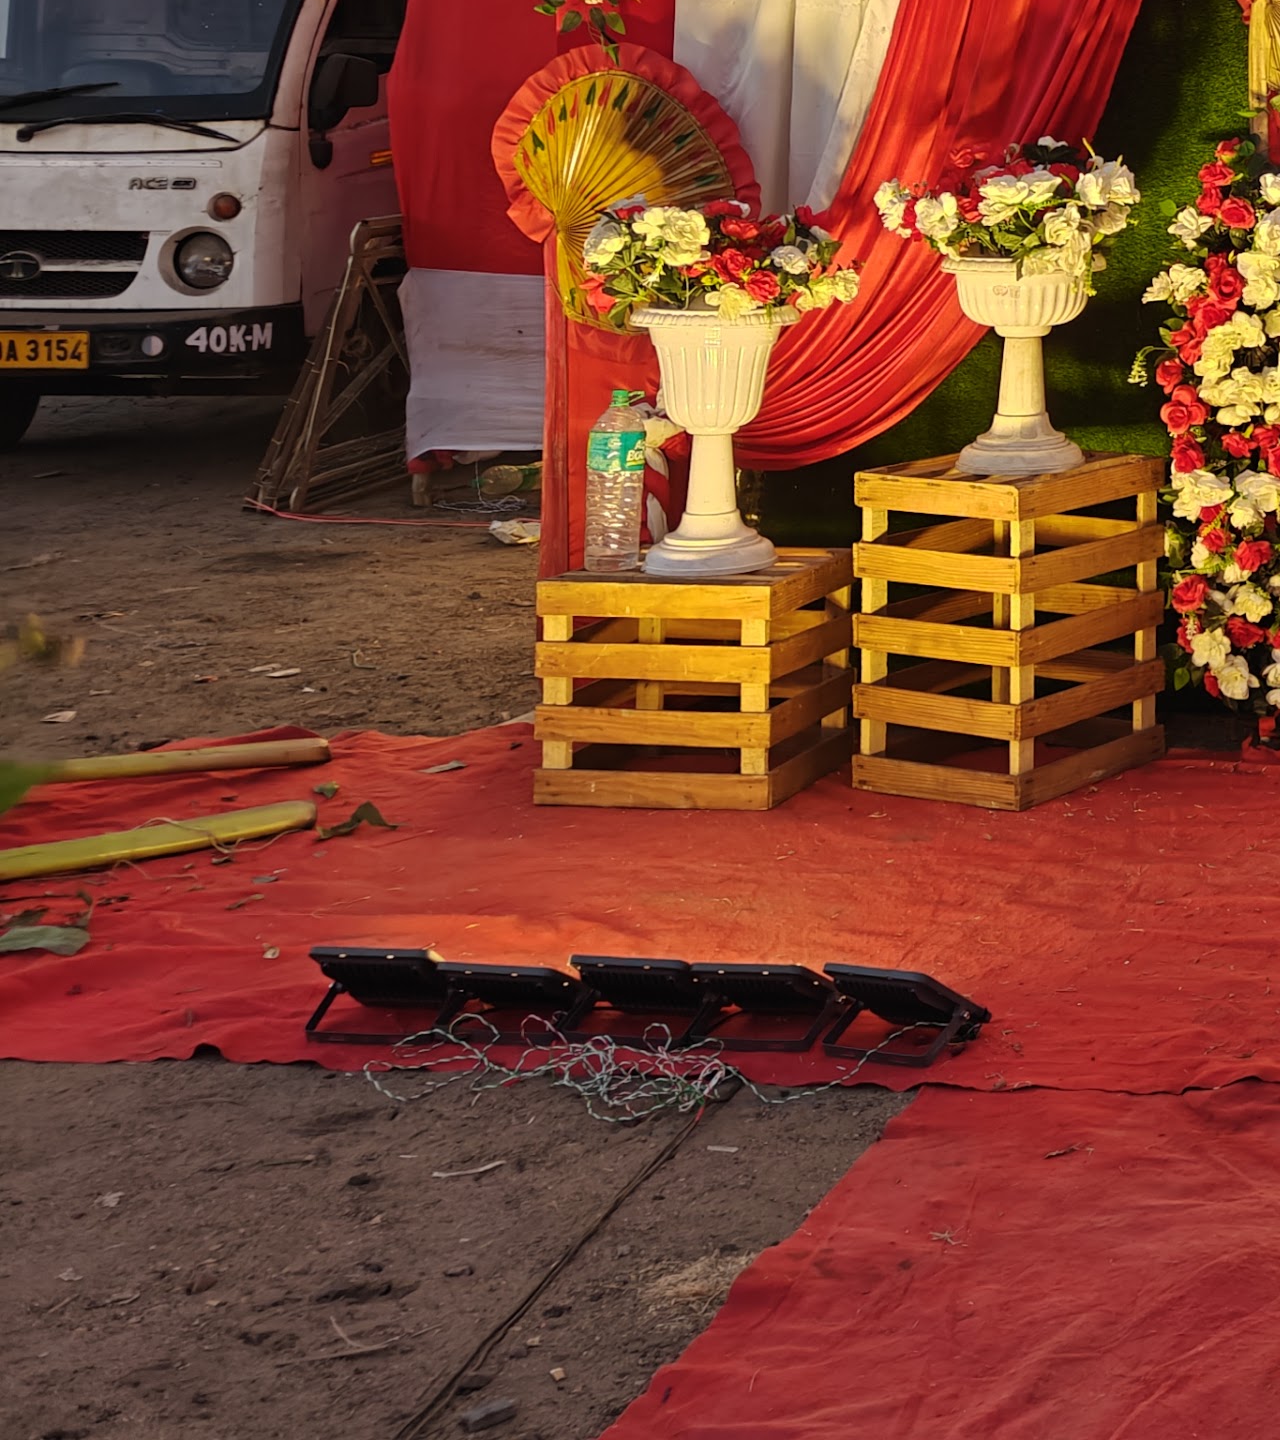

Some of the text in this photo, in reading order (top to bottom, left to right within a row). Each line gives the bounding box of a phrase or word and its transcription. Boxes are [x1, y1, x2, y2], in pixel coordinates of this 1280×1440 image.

[128, 177, 168, 190] ACE
[0, 339, 83, 362] A 3154
